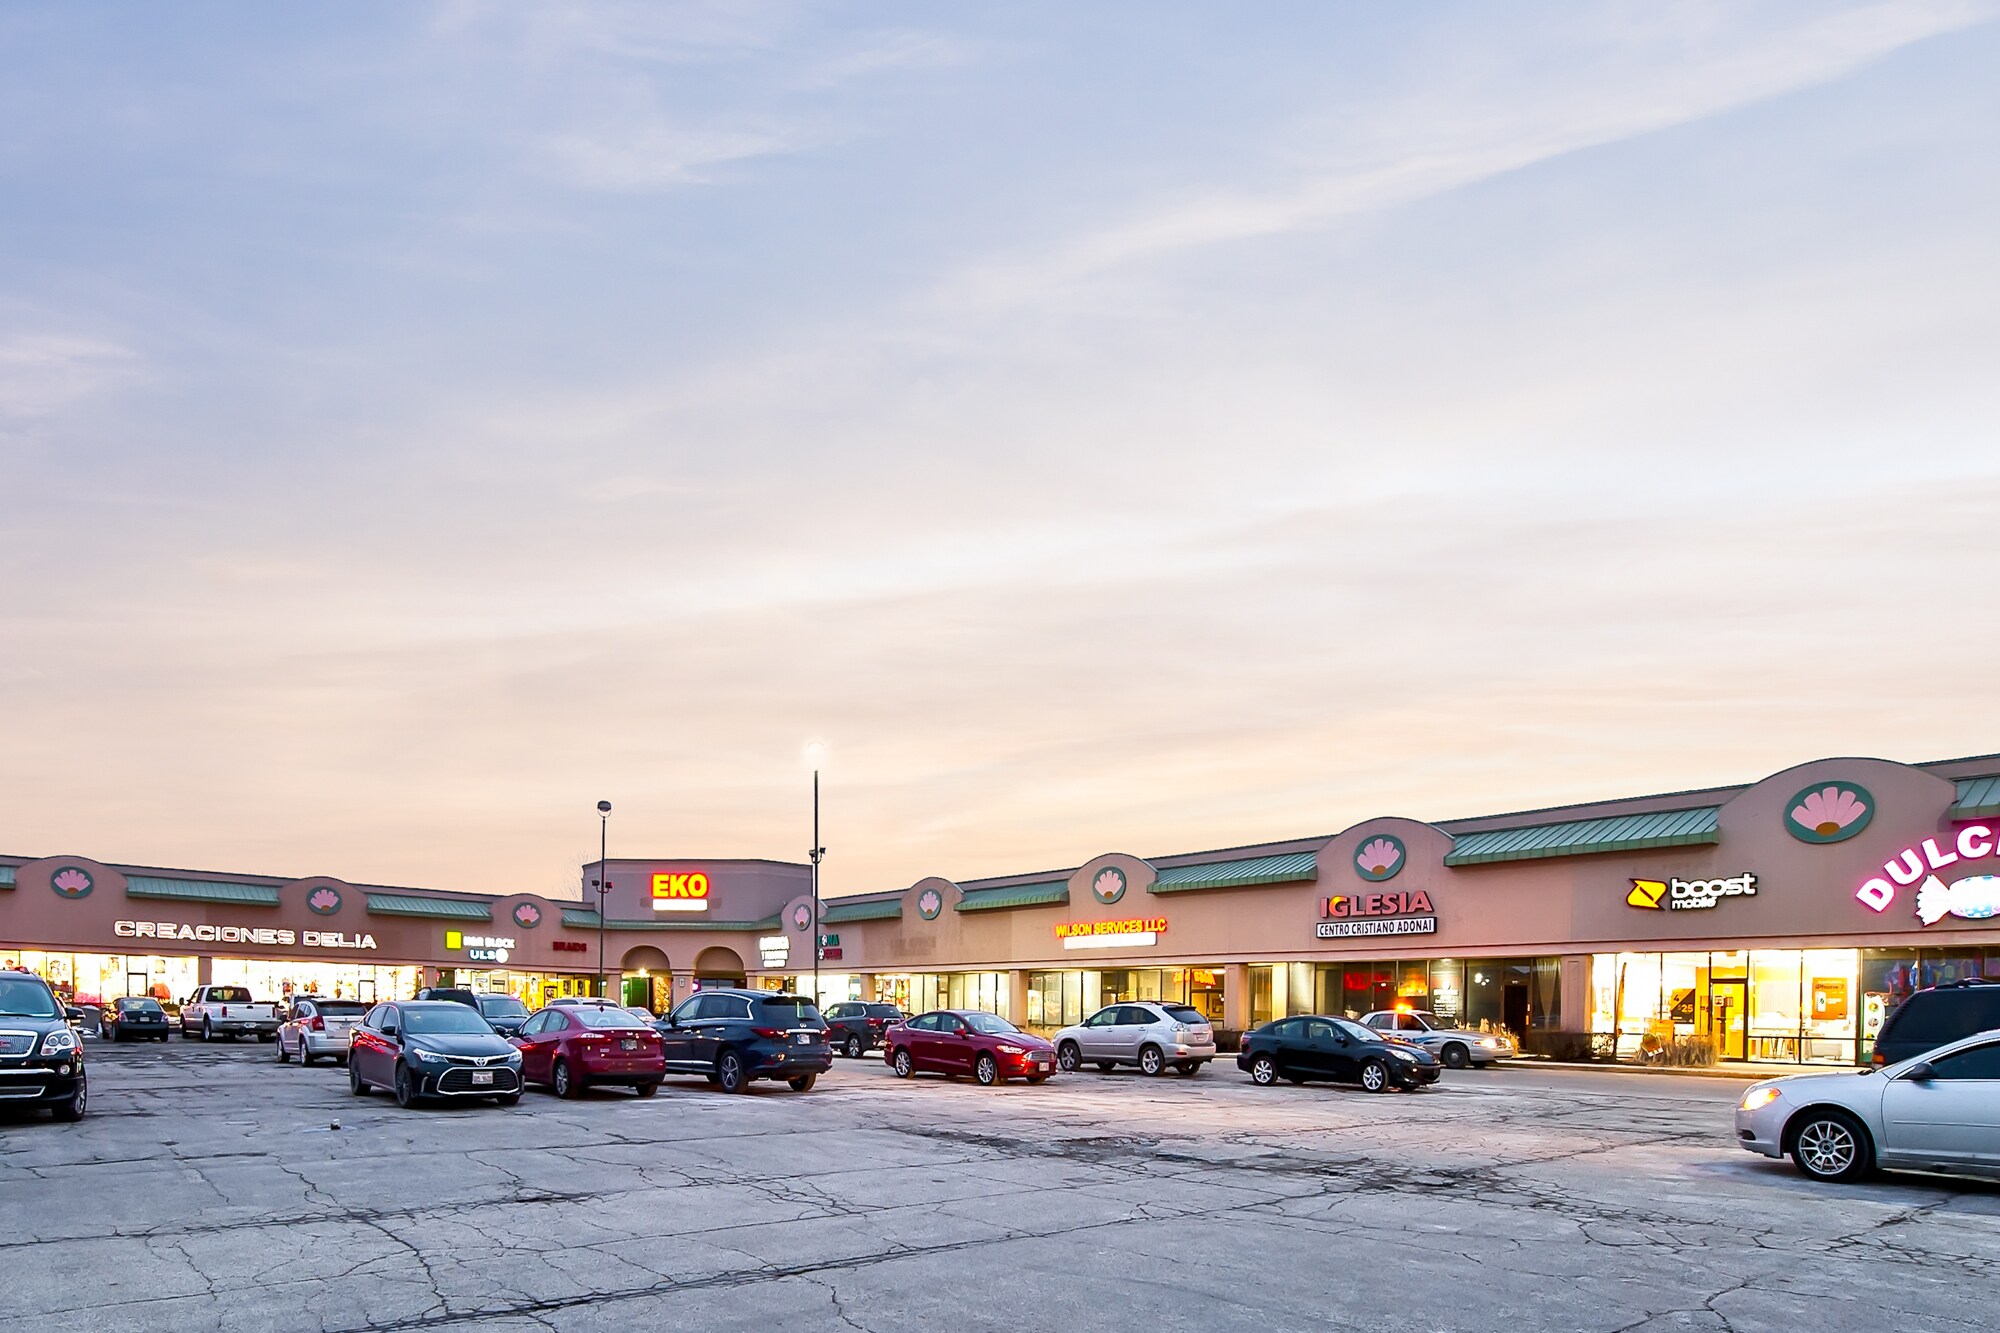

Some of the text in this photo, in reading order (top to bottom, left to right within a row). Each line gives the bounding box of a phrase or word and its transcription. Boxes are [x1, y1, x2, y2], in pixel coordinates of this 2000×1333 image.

[1855, 824, 2000, 913] DULC
[652, 873, 708, 897] EKO
[1671, 873, 1756, 898] boost
[1320, 890, 1433, 918] IGLESIA
[1671, 897, 1717, 910] mobile
[114, 920, 378, 949] CREACIONES DELIA
[1055, 918, 1167, 937] WILSON SERVICES LLC
[1319, 919, 1432, 936] CENTRO CRISTIANO ADONAI
